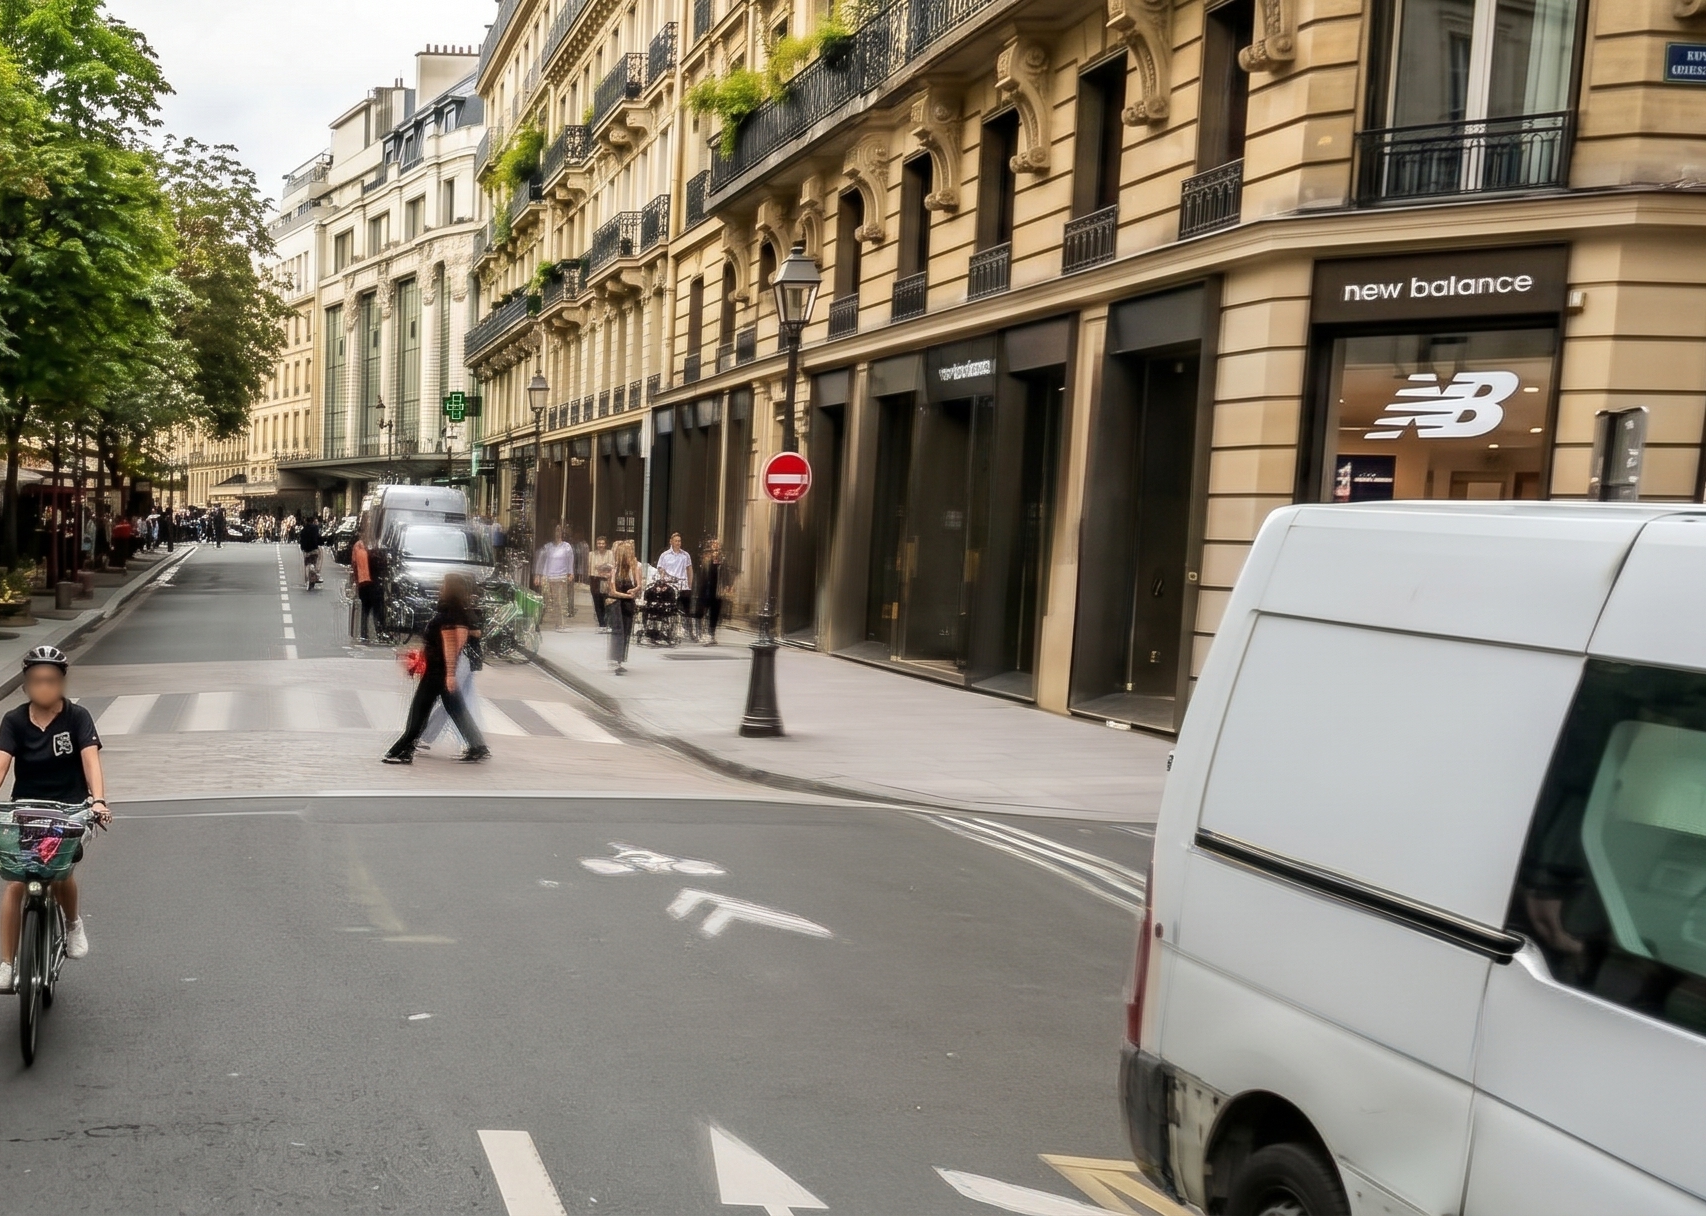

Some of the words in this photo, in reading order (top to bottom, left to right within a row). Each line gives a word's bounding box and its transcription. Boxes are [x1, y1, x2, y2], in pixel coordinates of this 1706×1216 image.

[1343, 283, 1403, 301] new
[1410, 274, 1533, 298] balance
[1363, 370, 1521, 440] NB
